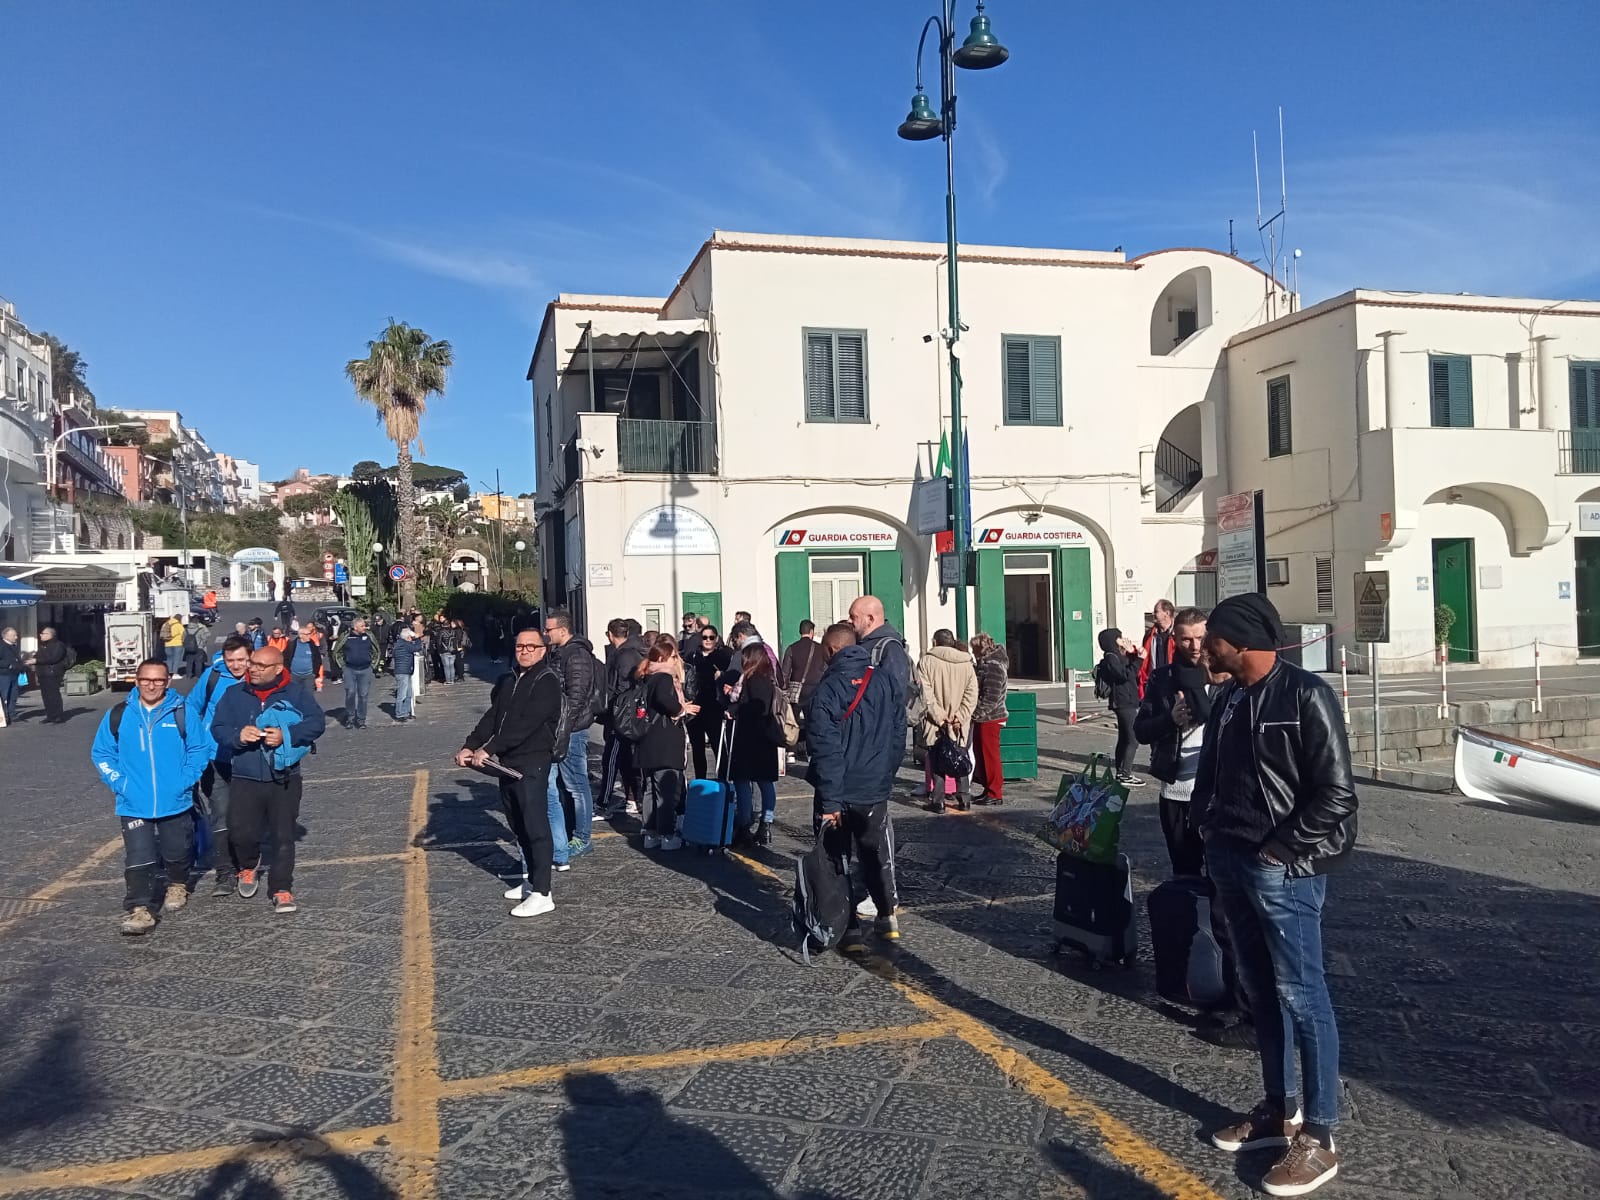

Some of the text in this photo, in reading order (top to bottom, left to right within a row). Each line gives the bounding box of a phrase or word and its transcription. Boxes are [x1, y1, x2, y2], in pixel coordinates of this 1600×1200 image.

[1590, 512, 1600, 520] AD
[808, 533, 892, 542] GUARDIA COSTIERA
[1005, 532, 1082, 540] GUARDIA COSTIERA
